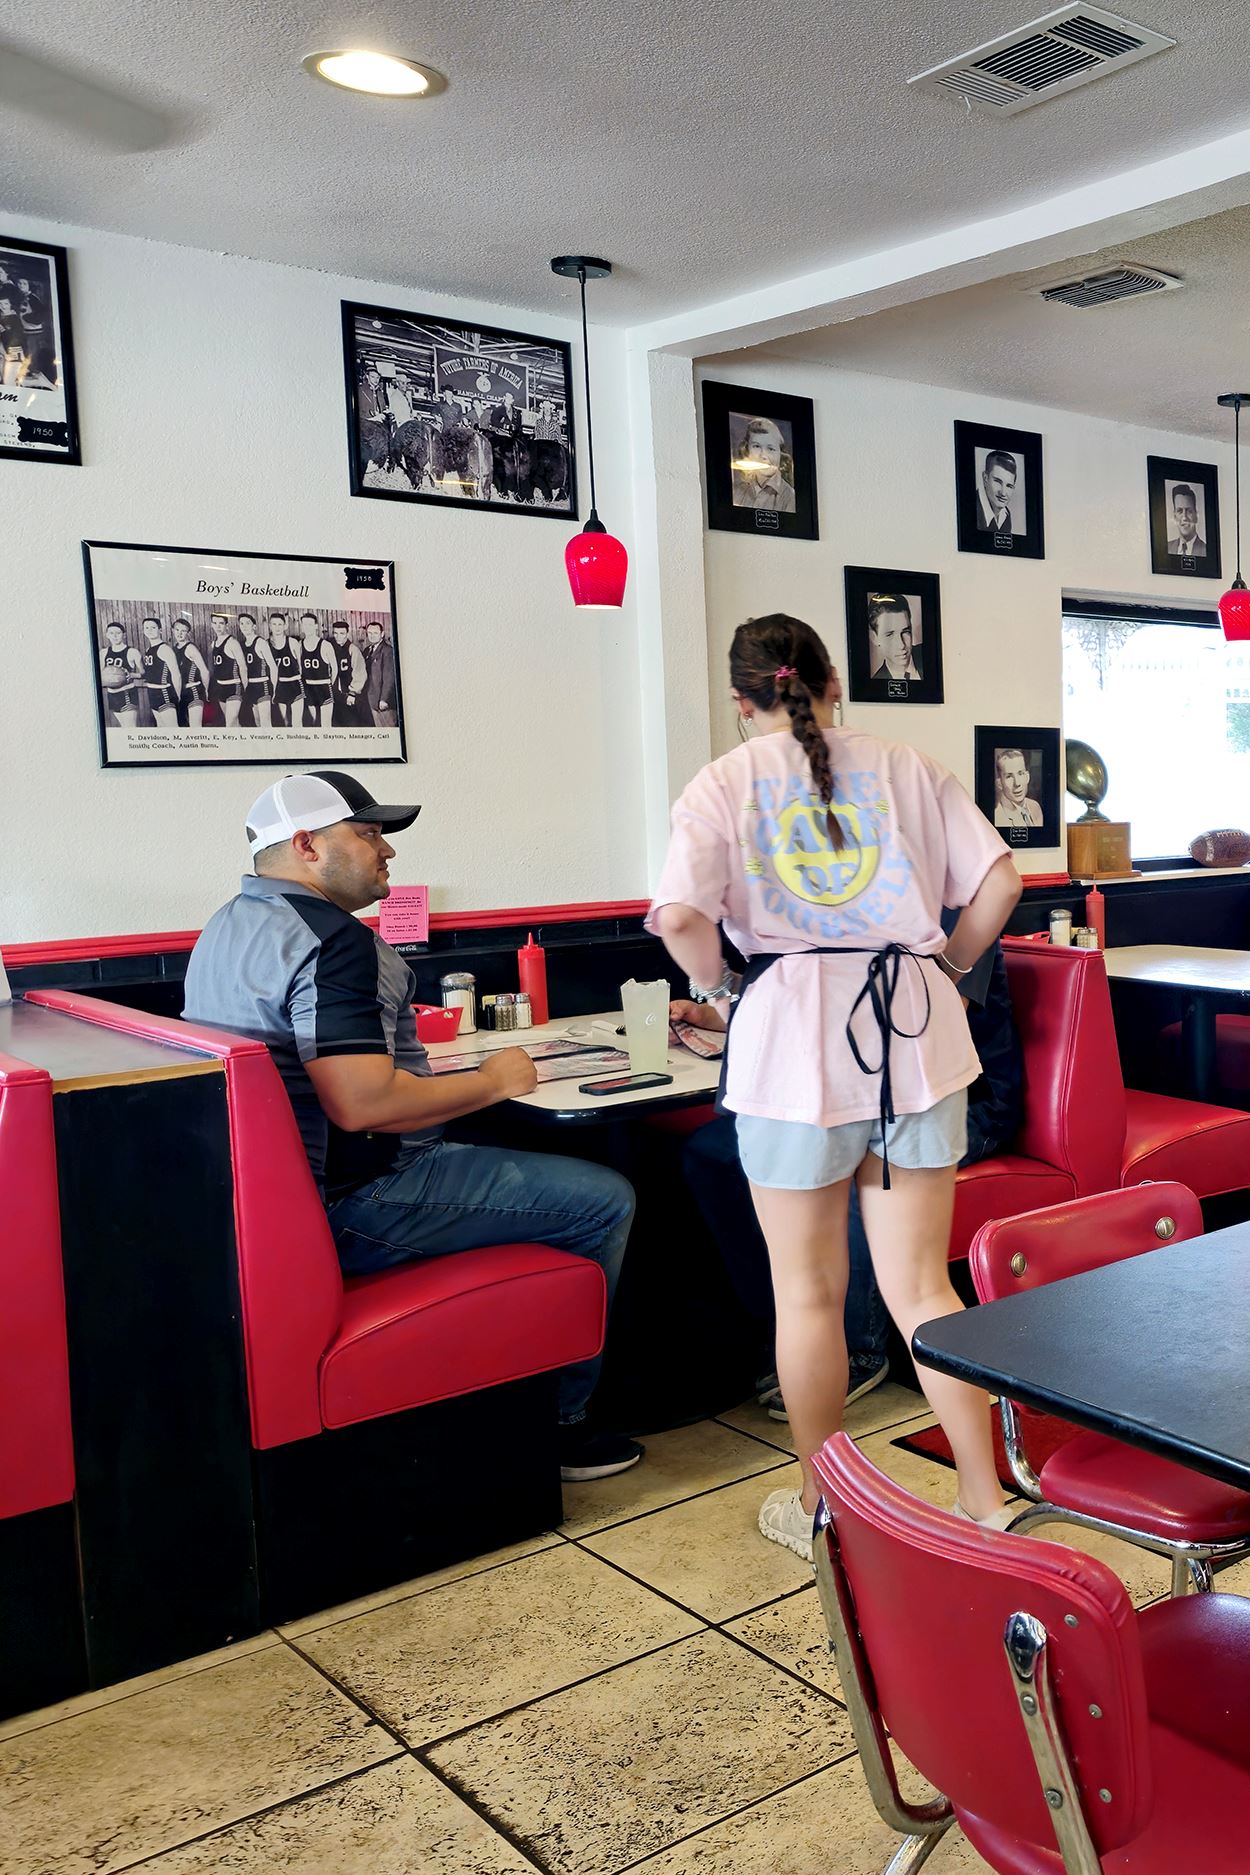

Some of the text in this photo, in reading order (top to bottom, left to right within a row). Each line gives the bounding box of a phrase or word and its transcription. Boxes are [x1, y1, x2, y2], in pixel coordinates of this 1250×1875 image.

[440, 358, 464, 376] FUTURE
[498, 366, 523, 390] AMERICA
[33, 427, 53, 436] 1950
[241, 582, 309, 598] Basketball
[303, 658, 319, 669] 60
[801, 862, 859, 897] OF
